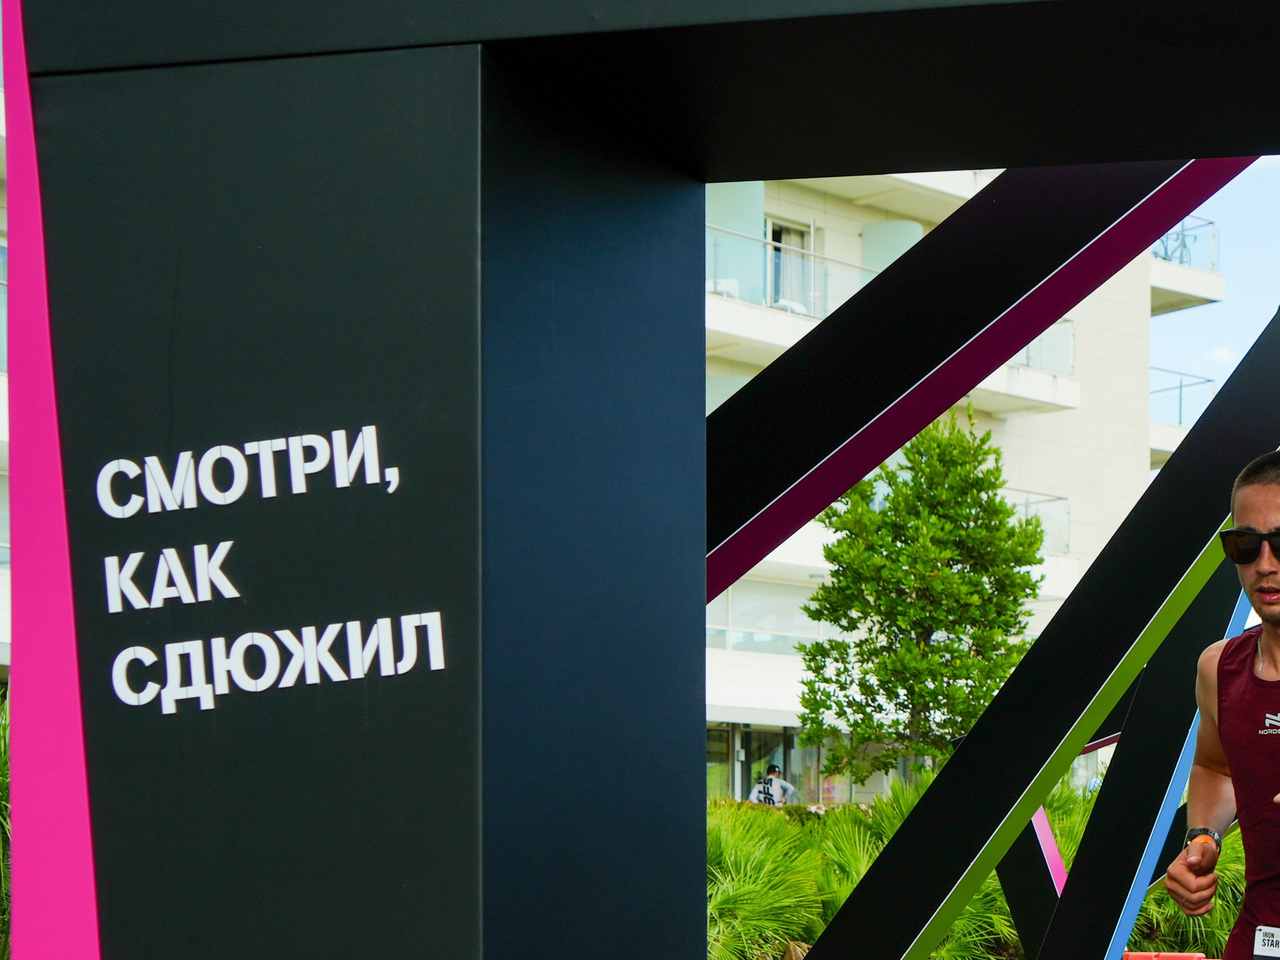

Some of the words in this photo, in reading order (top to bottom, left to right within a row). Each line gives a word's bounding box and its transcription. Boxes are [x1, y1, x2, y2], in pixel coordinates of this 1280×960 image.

[96, 425, 400, 519] СМОТРИ,
[104, 540, 241, 614] КАК
[112, 611, 445, 715] СДЮЖИЛ
[1261, 938, 1280, 949] STAR
[1262, 931, 1275, 939] IRON
